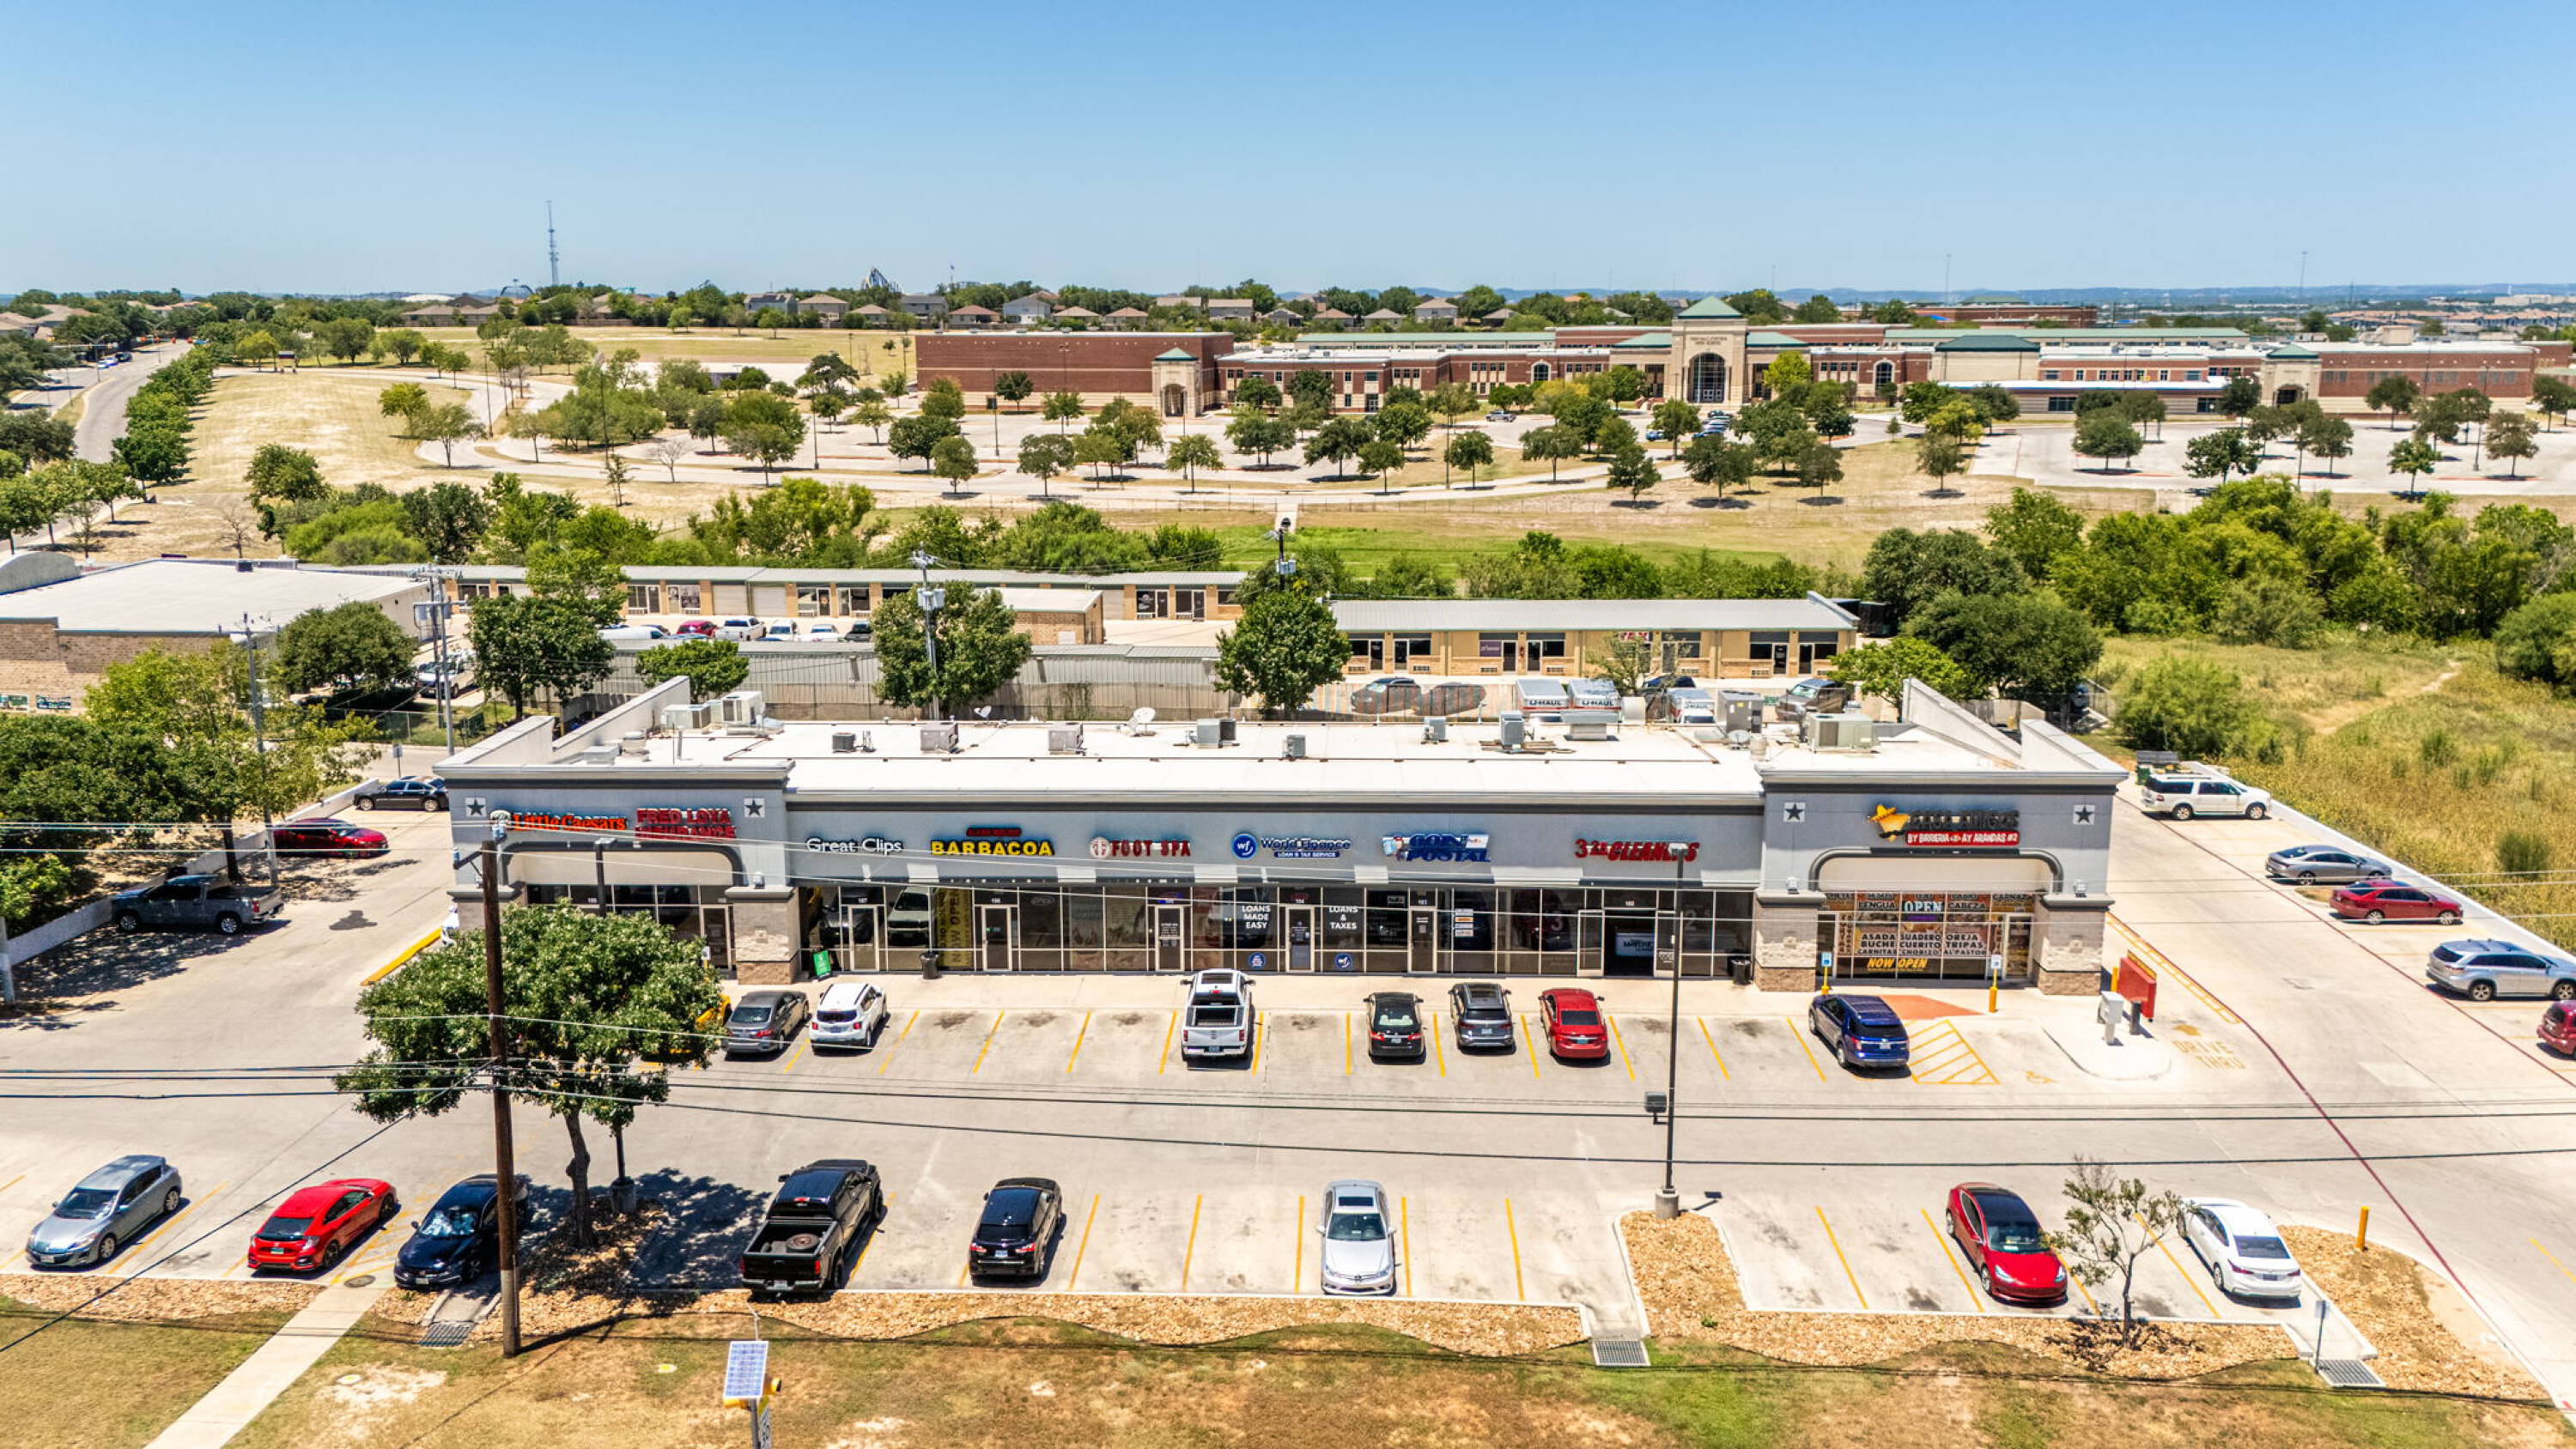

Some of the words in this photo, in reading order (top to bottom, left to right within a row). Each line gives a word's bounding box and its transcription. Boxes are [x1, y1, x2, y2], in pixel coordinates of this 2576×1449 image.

[512, 814, 560, 831] Little
[561, 815, 628, 831] Caesars
[636, 809, 683, 824] FRED
[687, 809, 732, 824] LOYA
[805, 837, 856, 852] Great
[861, 837, 902, 856] Clips
[930, 840, 1054, 857] BARBACOA
[1112, 840, 1153, 857] FOOT
[1161, 840, 1191, 857] SPA
[1261, 838, 1297, 849] World
[1301, 838, 1352, 850] Finance
[1607, 840, 1700, 862] CLEANS
[1904, 900, 1942, 912] OPEN
[1866, 958, 1896, 968] NOW
[1897, 958, 1929, 968] OPEN
[2172, 1040, 2235, 1054] DRIVE
[2194, 1056, 2246, 1069] THRU
